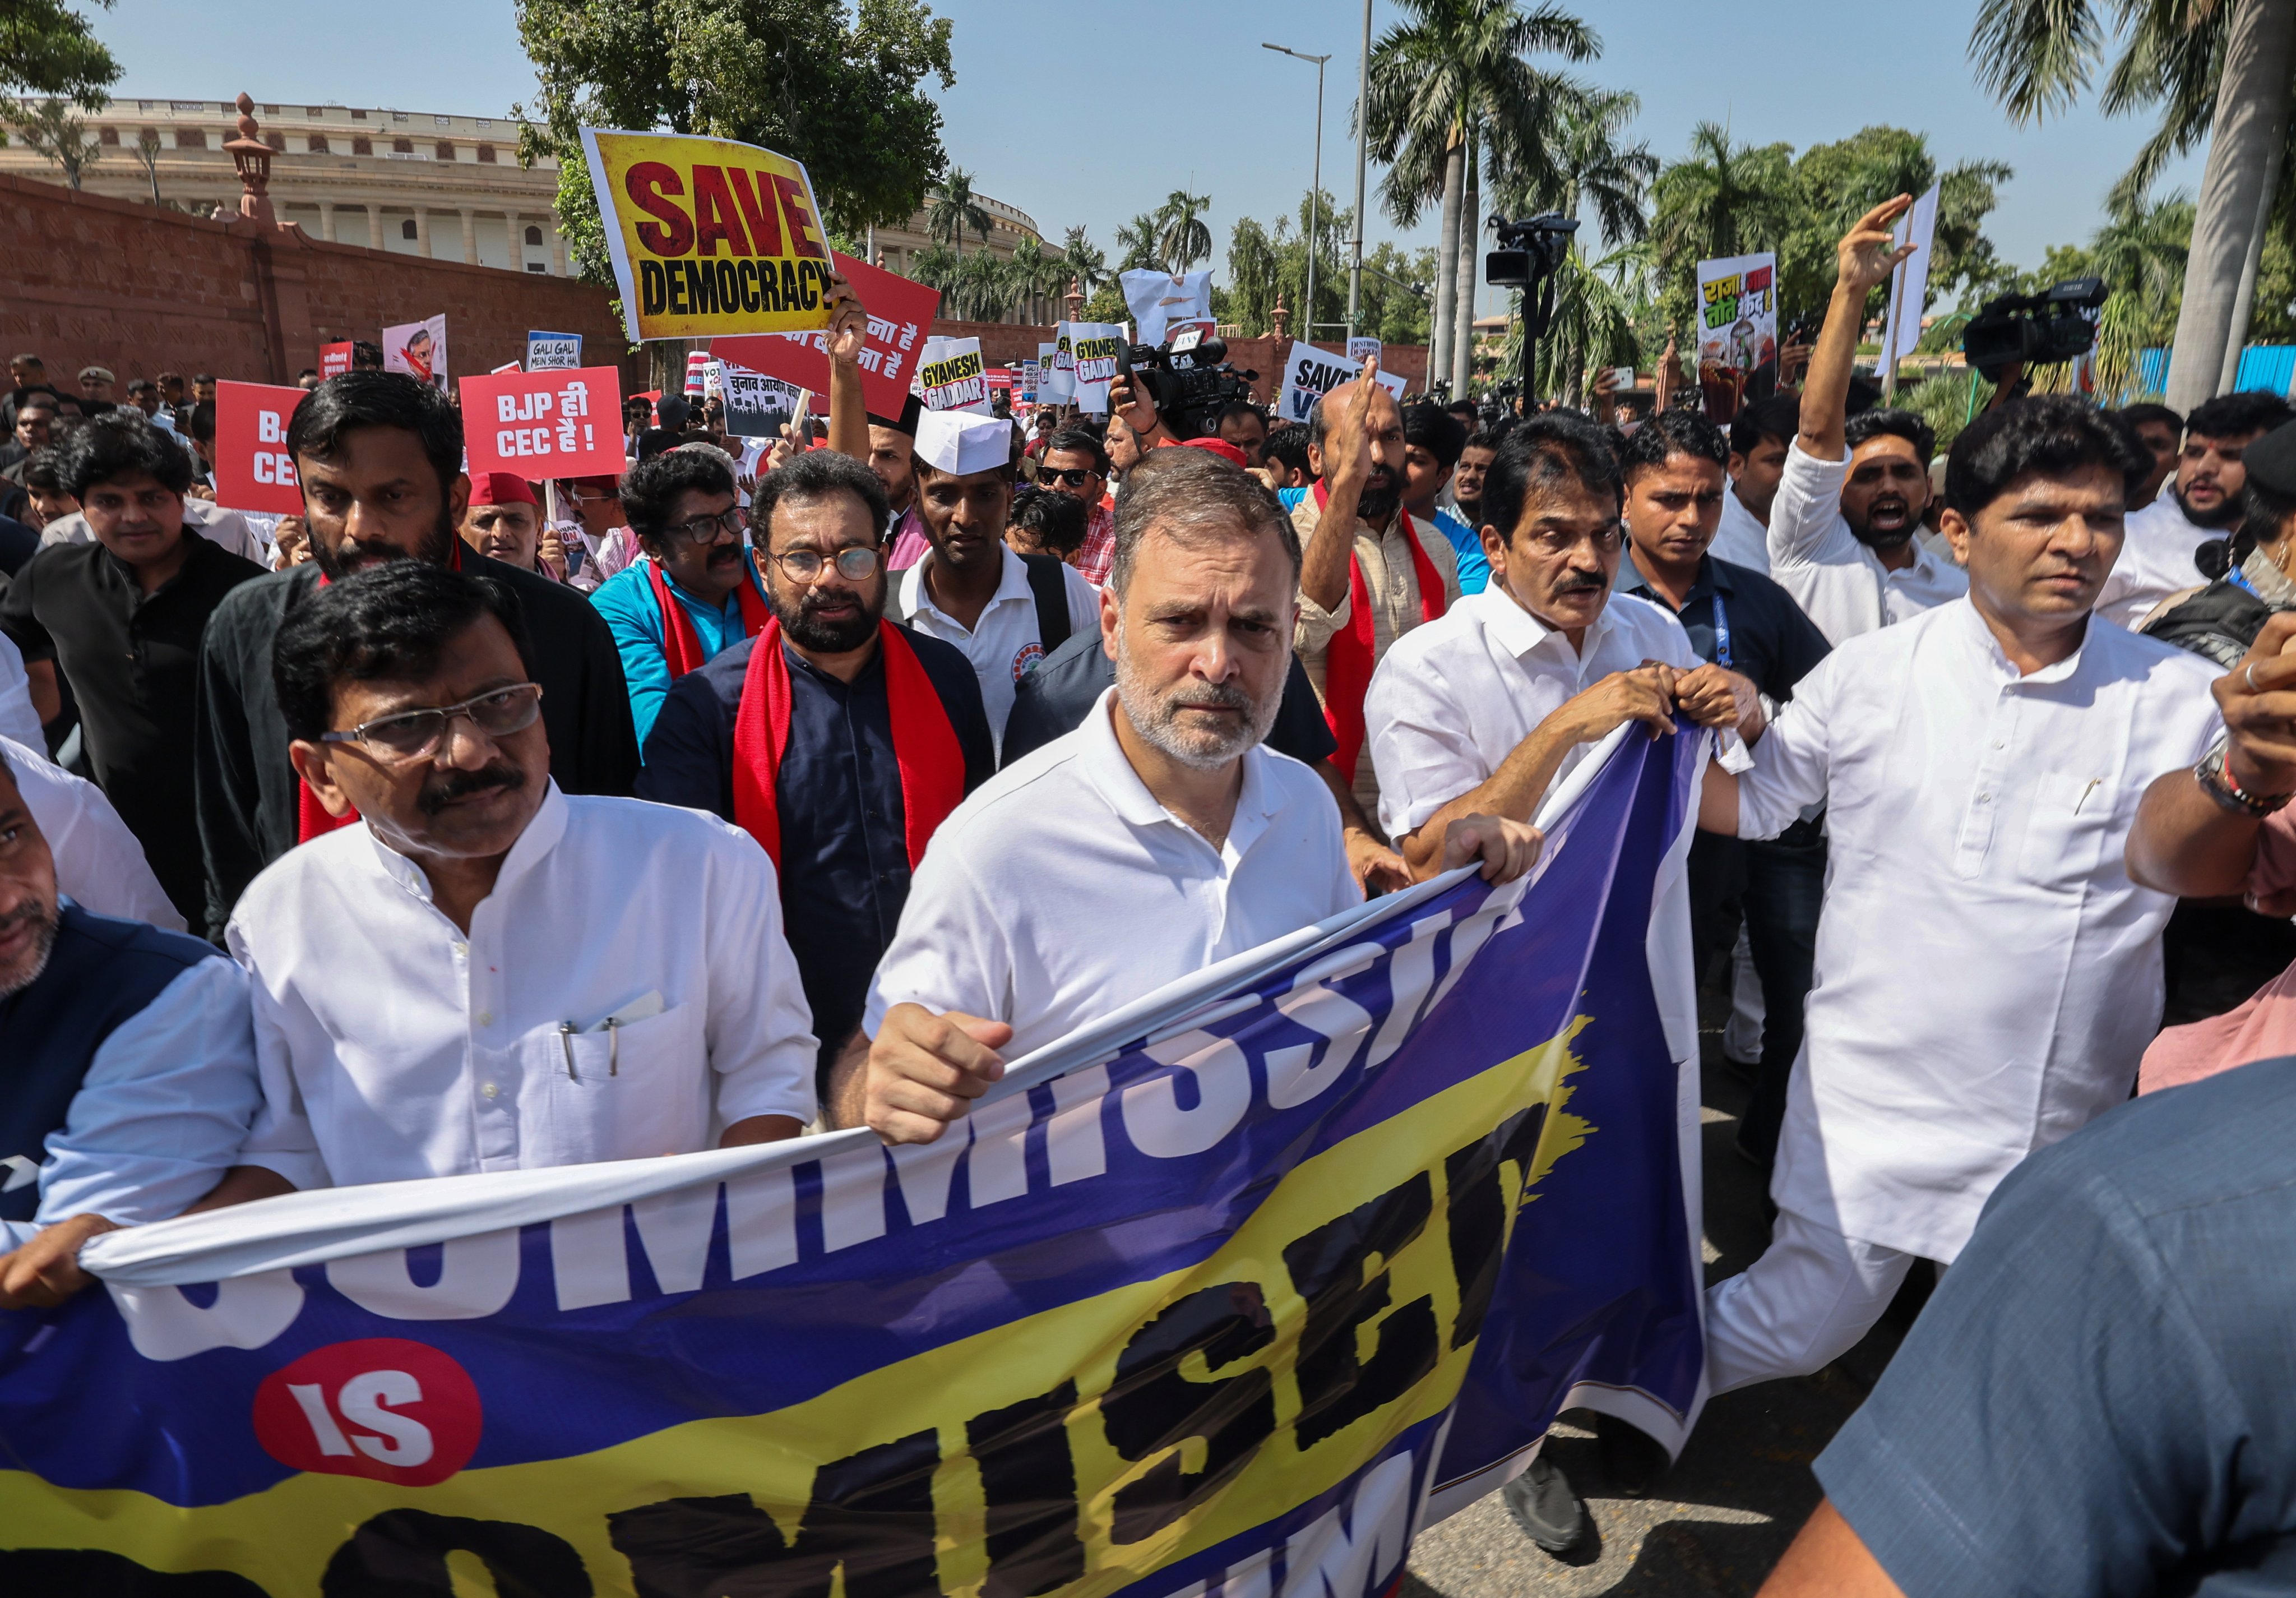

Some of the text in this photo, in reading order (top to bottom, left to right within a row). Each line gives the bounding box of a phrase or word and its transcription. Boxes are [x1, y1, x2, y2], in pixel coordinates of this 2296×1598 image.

[625, 161, 828, 259] SAVE
[638, 258, 835, 316] DEMOCRACY
[1702, 274, 1741, 303] राजा
[534, 343, 574, 355] GALI GALI
[899, 321, 918, 351] है
[531, 357, 546, 368] MEIN
[548, 355, 565, 366] SHOR
[883, 350, 902, 380] है
[922, 352, 980, 387] GYANESH
[1078, 358, 1116, 382] GADD
[497, 381, 588, 422] BJP ही
[729, 376, 758, 395] चुनाव
[760, 378, 786, 395] आयोग
[927, 377, 983, 412] GADDAR
[497, 427, 551, 458] CEC
[556, 418, 576, 452] है
[254, 451, 300, 487] CE
[287, 1368, 434, 1467] IS
